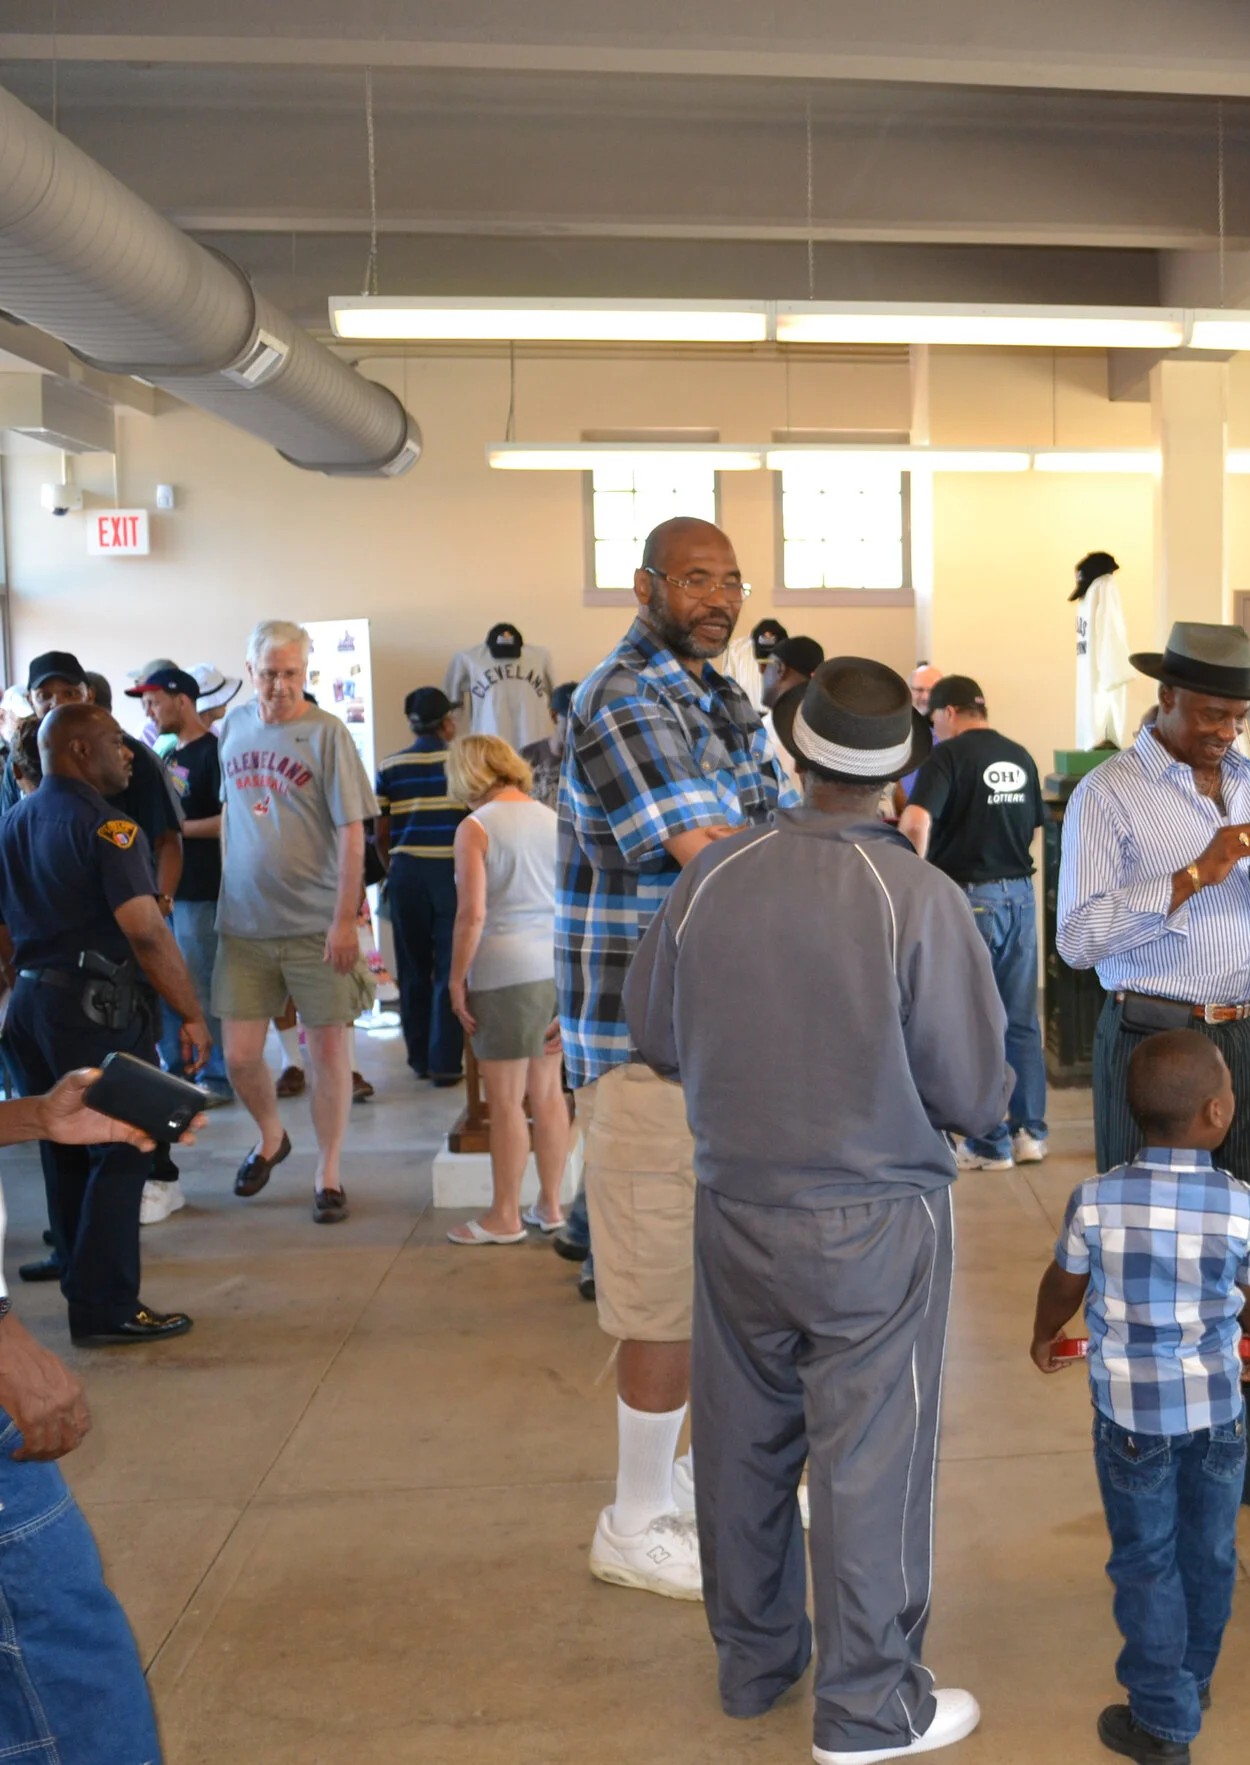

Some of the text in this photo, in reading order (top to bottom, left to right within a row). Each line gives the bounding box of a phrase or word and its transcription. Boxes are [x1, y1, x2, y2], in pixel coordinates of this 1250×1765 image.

[97, 516, 139, 547] EXIT
[226, 750, 314, 787] CLEVELAND
[988, 769, 1020, 784] OH!
